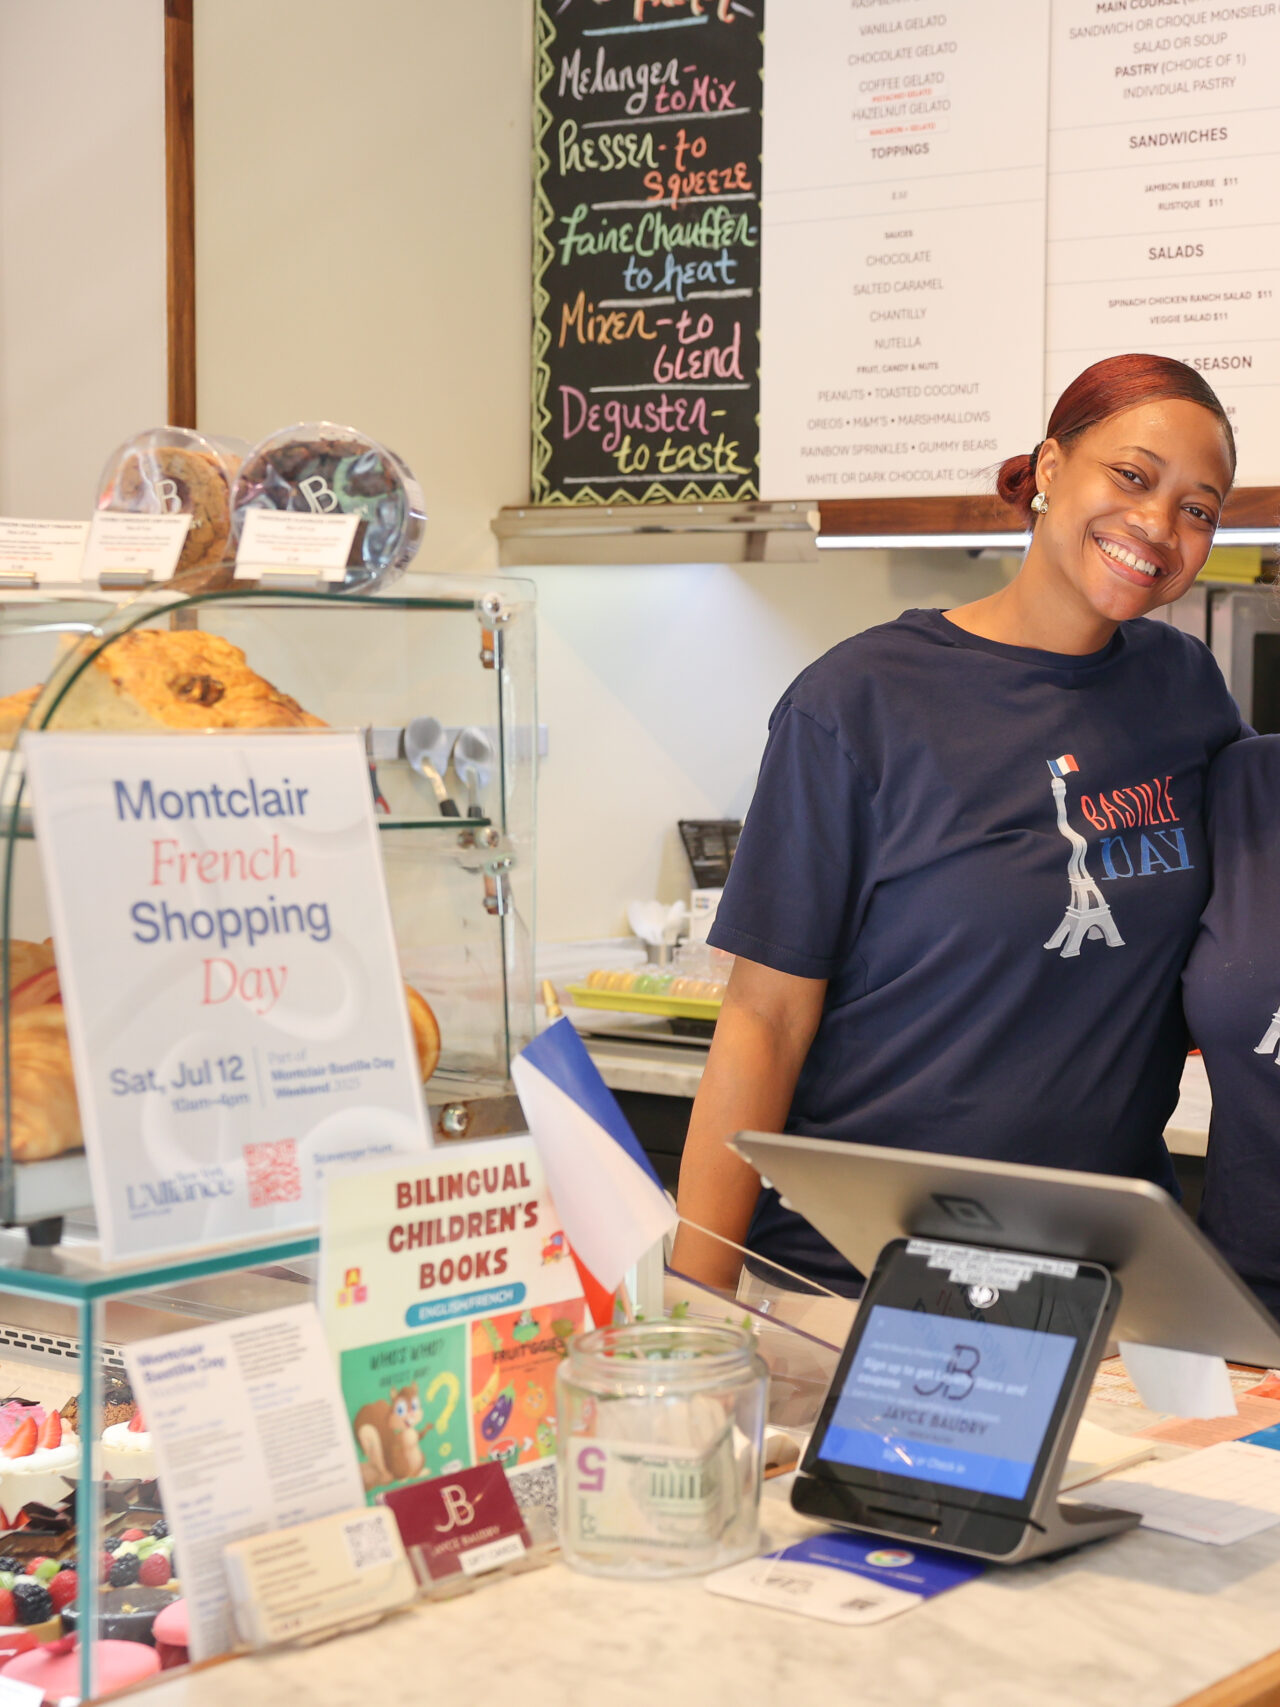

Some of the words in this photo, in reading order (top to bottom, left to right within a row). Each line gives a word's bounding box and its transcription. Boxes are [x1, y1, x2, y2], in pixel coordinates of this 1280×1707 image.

[1096, 1, 1127, 13] MAIN
[860, 18, 903, 36] VANILLA
[905, 14, 947, 31] GELATO
[1069, 18, 1133, 39] SANDWICH
[1136, 17, 1153, 31] OR
[1156, 11, 1207, 29] CROQUE
[1210, 5, 1276, 23] MONSIEUR
[848, 46, 913, 66] CHOCOLATE
[916, 41, 958, 58] GELATO
[1133, 38, 1170, 54] SALAD
[1173, 36, 1190, 50] OR
[1193, 32, 1228, 47] SOUP
[1114, 63, 1158, 78] PASTRY
[1161, 56, 1214, 75] (CHOICE
[1216, 54, 1232, 67] OF
[1235, 53, 1247, 67] 1)
[858, 76, 900, 93] COFFEE
[903, 71, 944, 88] GELATO
[1123, 83, 1190, 99] INDIVIDUAL
[1193, 76, 1236, 92] PASTRY
[655, 85, 687, 113] to
[688, 75, 736, 112] Mix
[851, 104, 907, 121] HAZELNUT
[910, 99, 951, 115] GELATO
[1129, 127, 1228, 149] SANDWICHES
[674, 128, 707, 172] to
[871, 142, 930, 160] TOPPINGS
[1144, 181, 1180, 193] JAMBON
[1182, 179, 1215, 190] BEURRE
[1223, 177, 1239, 187] $11
[1158, 199, 1201, 211] RUSTIQUE
[1208, 198, 1224, 208] $11
[866, 250, 931, 267] CHOCOLATE
[1148, 244, 1204, 260] SALADS
[623, 255, 652, 291] to
[653, 248, 738, 301] heat
[853, 282, 892, 296] SALTED
[894, 278, 944, 292] CARAMEL
[1108, 297, 1146, 308] SPINACH
[1148, 295, 1187, 305] CHICKEN
[1189, 293, 1221, 303] RANCH
[1223, 291, 1252, 301] SALAD
[1257, 290, 1273, 300] $11
[869, 308, 927, 322] CHANTILLY
[1149, 314, 1181, 325] VEGGIE
[1183, 313, 1212, 323] SALAD
[1213, 311, 1228, 321] $11
[676, 310, 714, 344] to
[874, 337, 922, 350] NUTELLA
[918, 362, 939, 371] NUTS
[1194, 356, 1252, 371] SEASON
[818, 389, 865, 402] PEANUTS
[875, 386, 922, 399] TOASTED
[923, 383, 980, 397] COCONUT
[807, 418, 844, 430] OREOS
[898, 411, 991, 426] MARSHMALLOWS
[613, 435, 650, 474] to
[656, 433, 752, 475] taste
[800, 446, 850, 458] RAINBOW
[851, 442, 909, 456] SPRINKLES
[918, 440, 960, 452] GUMMY
[962, 439, 998, 451] BEARS
[806, 473, 838, 485] WHITE
[840, 472, 857, 484] OR
[859, 471, 887, 483] DARK
[889, 469, 954, 482] CHOCOLATE
[113, 779, 310, 821] Montclair
[1080, 776, 1180, 831] BASTILLE
[150, 835, 298, 886] French
[1099, 827, 1195, 881] DAY
[130, 897, 332, 948] Shopping
[201, 957, 288, 1015] Day
[110, 1067, 165, 1096] Sat,
[171, 1060, 211, 1089] Jul
[218, 1055, 245, 1083] 12
[396, 1162, 531, 1210] BILINGUAL
[388, 1200, 539, 1253] CHILDREN'S
[419, 1247, 508, 1290] BOOKS
